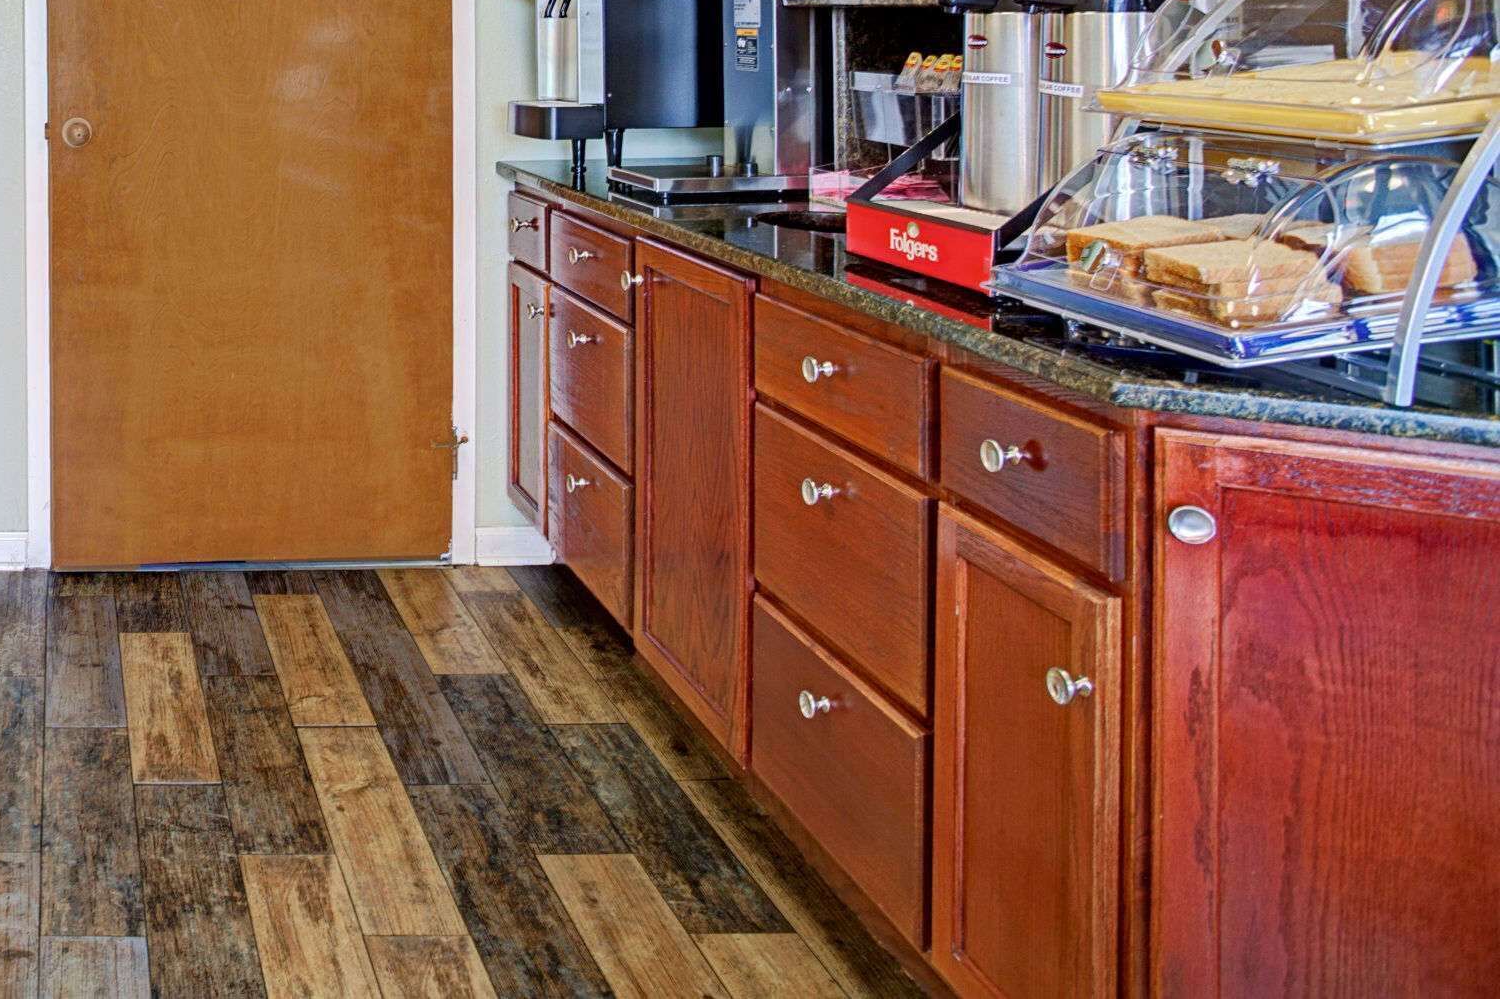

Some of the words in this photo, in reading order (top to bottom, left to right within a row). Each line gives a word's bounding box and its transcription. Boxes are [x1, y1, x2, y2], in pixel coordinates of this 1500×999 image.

[981, 75, 1009, 83] COFFEE
[1054, 84, 1081, 95] COFFEE
[889, 227, 940, 262] Folgers
